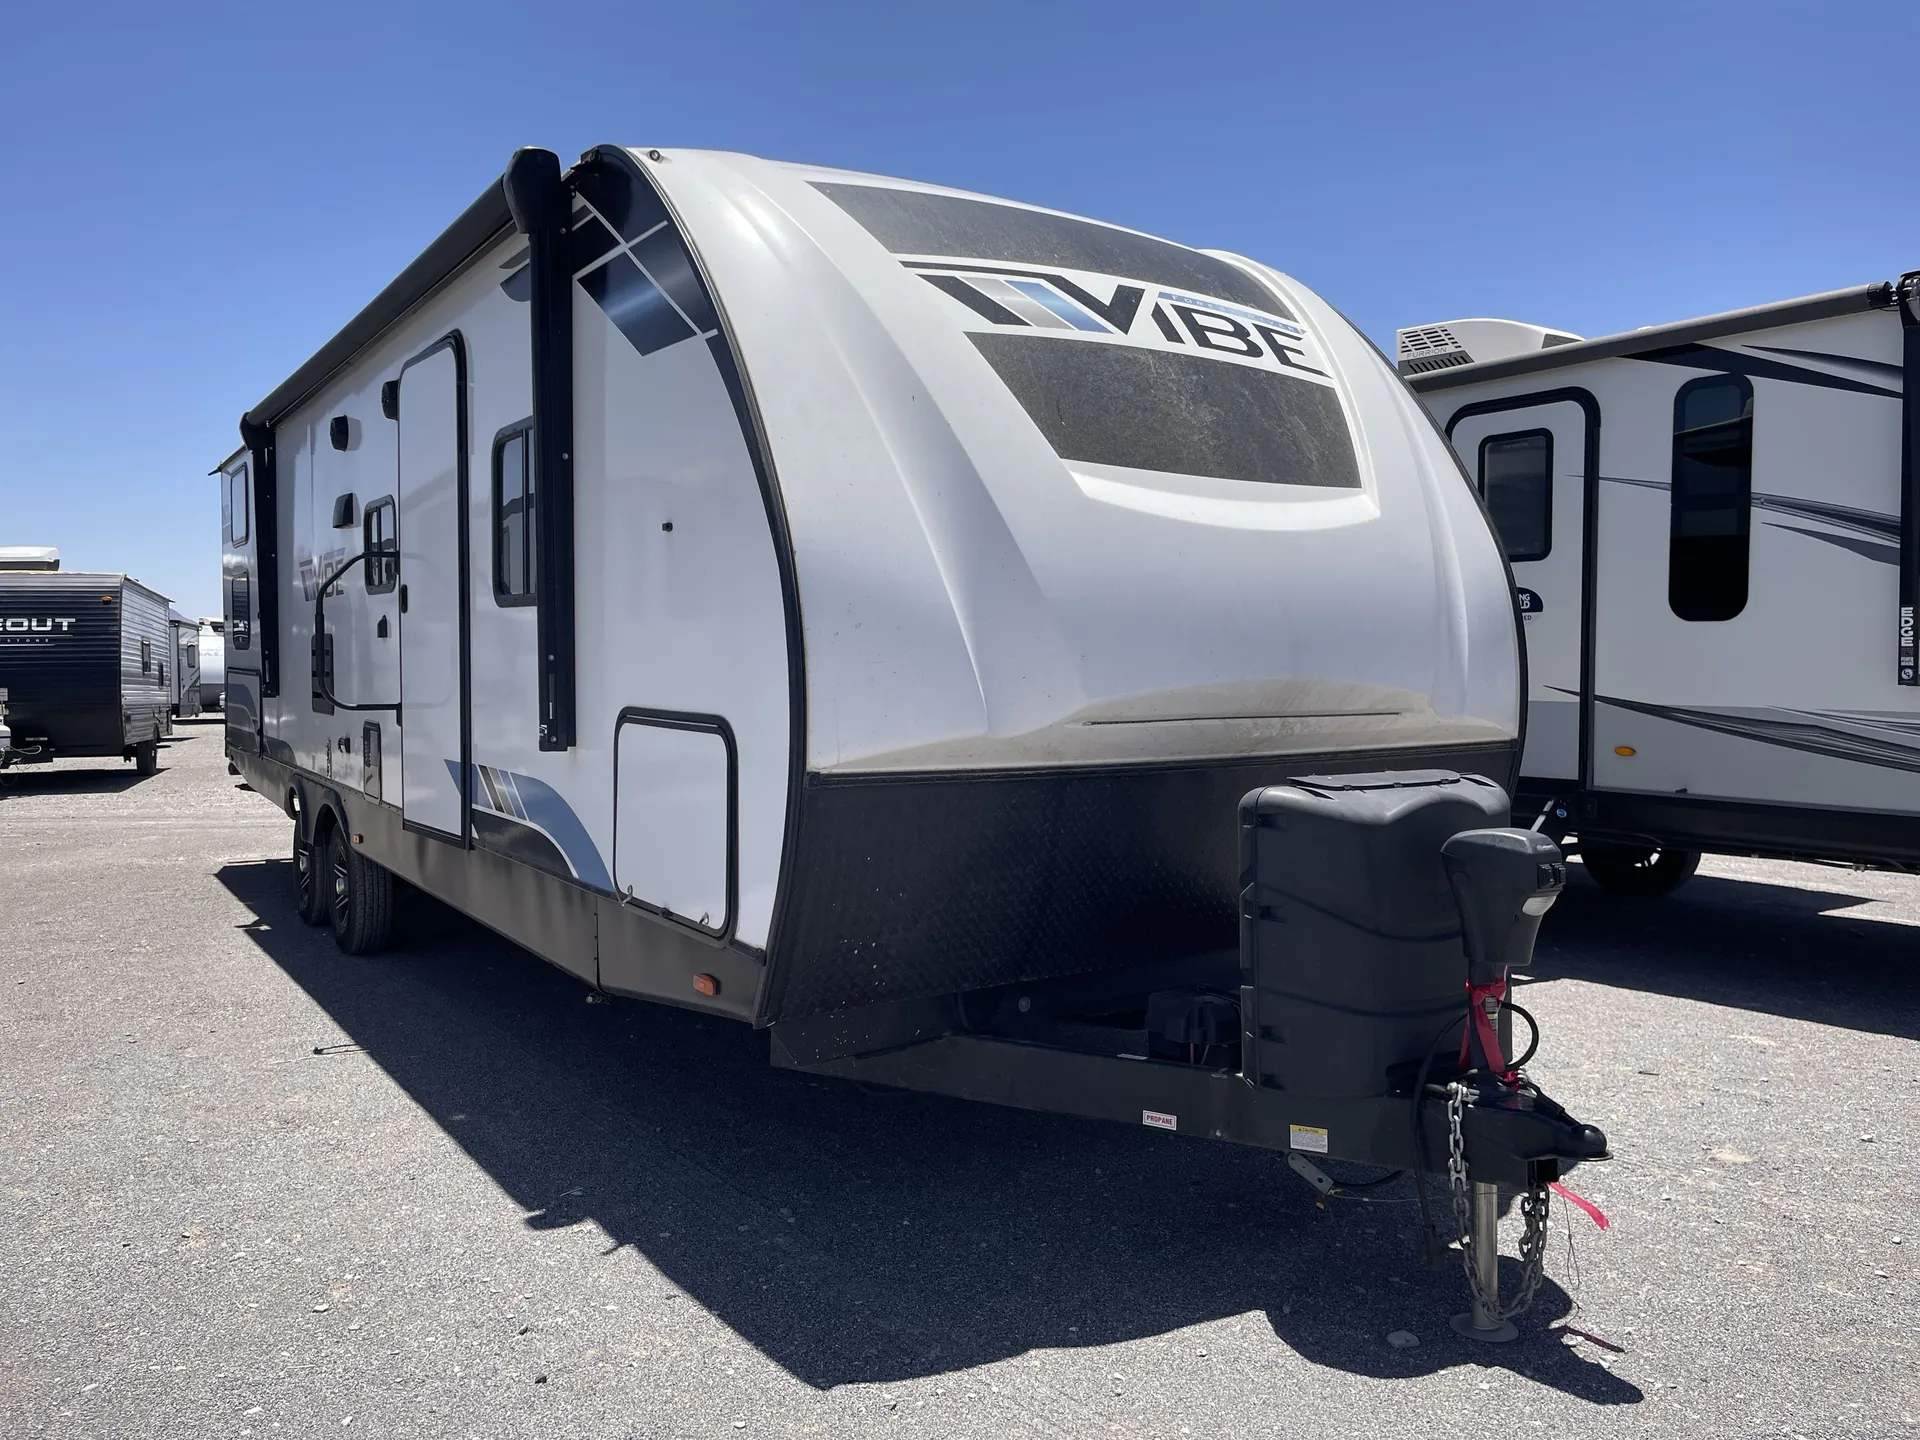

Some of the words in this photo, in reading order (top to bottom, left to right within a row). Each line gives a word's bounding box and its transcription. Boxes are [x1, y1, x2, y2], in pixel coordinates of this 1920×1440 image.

[1036, 272, 1333, 379] VIBE
[1247, 313, 1297, 332] RIVER
[1407, 347, 1447, 358] FURRION
[0, 618, 76, 631] OUT
[1900, 606, 1914, 647] EDGE
[1146, 1114, 1173, 1126] PROPANE
